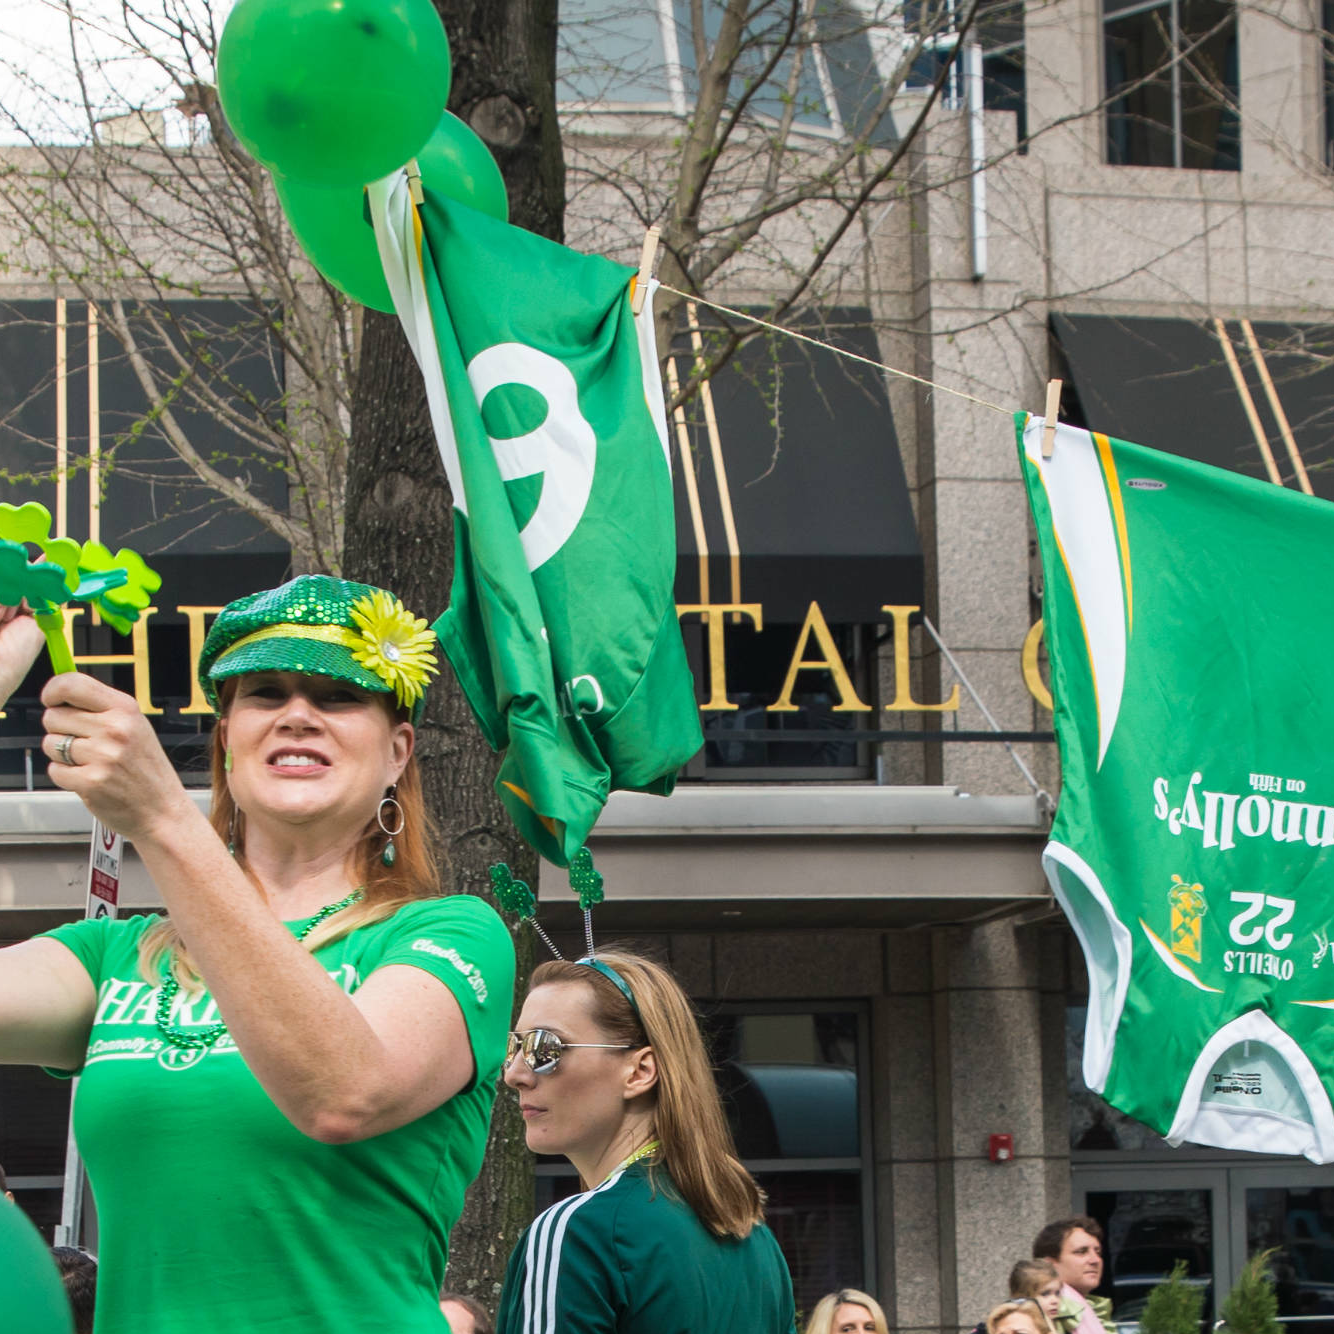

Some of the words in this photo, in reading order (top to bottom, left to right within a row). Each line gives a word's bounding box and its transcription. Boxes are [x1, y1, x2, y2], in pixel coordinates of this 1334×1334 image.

[1249, 773, 1282, 793] Fifth
[1228, 891, 1296, 951] 22
[1223, 950, 1295, 981] O'NEILLS
